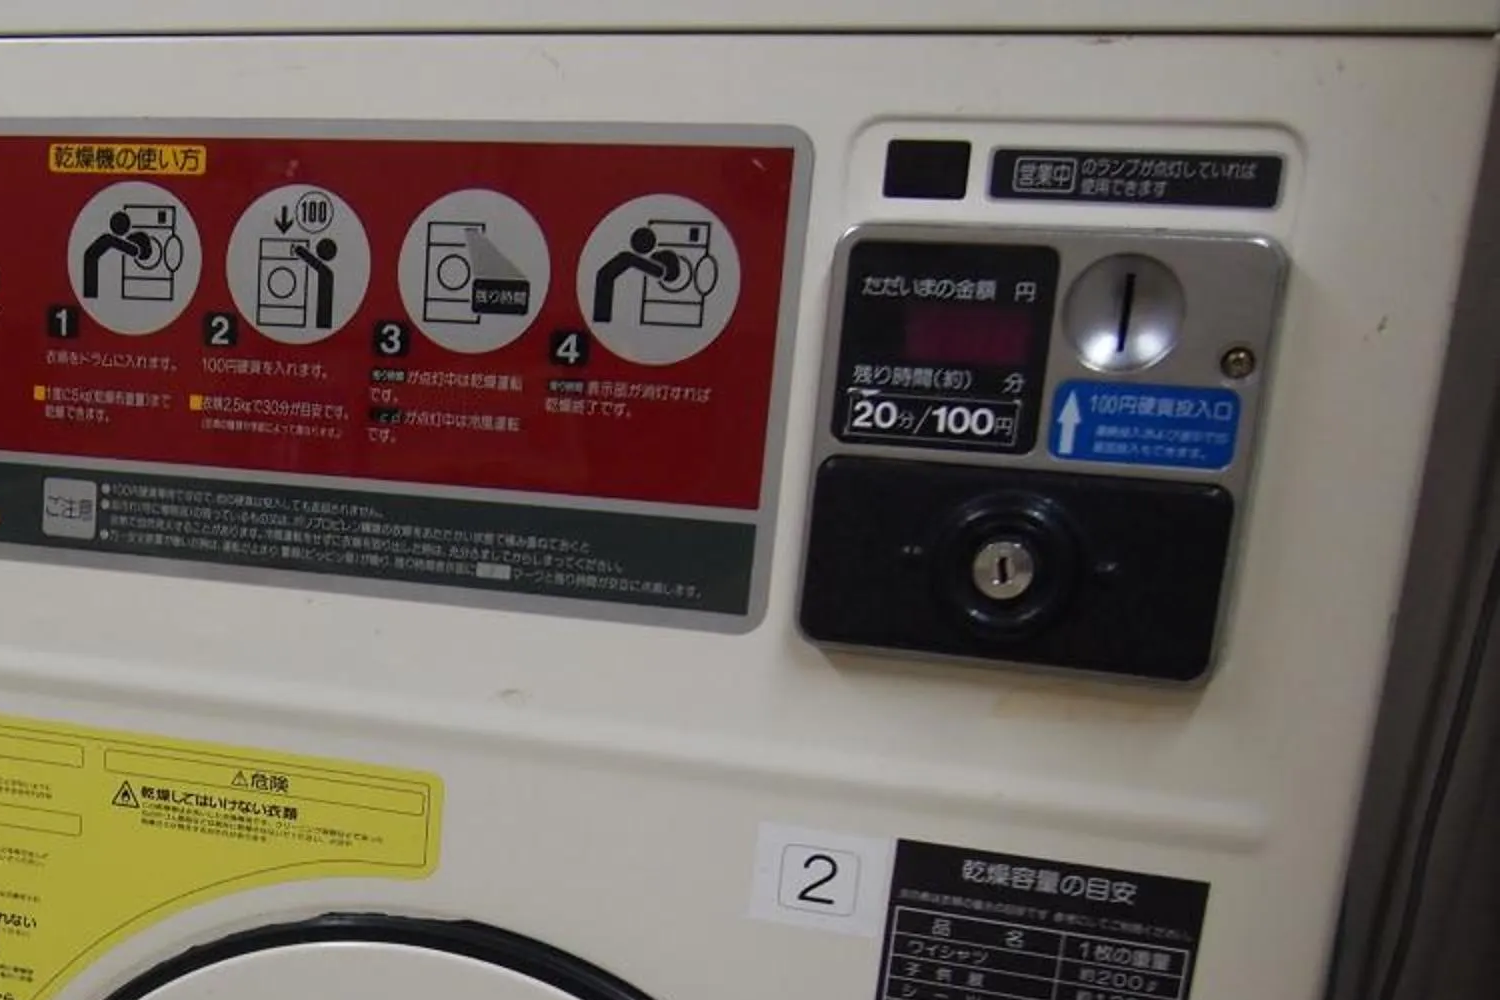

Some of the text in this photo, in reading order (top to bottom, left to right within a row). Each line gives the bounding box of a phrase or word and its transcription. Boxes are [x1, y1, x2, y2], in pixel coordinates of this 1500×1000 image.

[53, 145, 202, 172] 乾燥機の使い方
[1081, 158, 1257, 181] のランプが点灯していれば
[1018, 161, 1072, 188] 営業中
[1080, 179, 1167, 199] 使用できます
[301, 202, 328, 224] 100
[861, 275, 1036, 304] ただいまの金額 円
[55, 309, 70, 336] 1
[209, 314, 230, 345] 2
[380, 324, 401, 354] 3
[555, 333, 581, 364] 4
[851, 364, 1025, 394] 残り時間(約) 分
[1089, 394, 1234, 421] 100円硬貨投入口
[251, 772, 290, 793] 危険
[142, 786, 298, 821] 乾燥してはいけない衣類
[798, 853, 838, 905] 2
[961, 859, 1138, 907] 乾燥容量の目安
[907, 939, 989, 965] ワイシャツ
[1079, 941, 1171, 971] 1枚の重量
